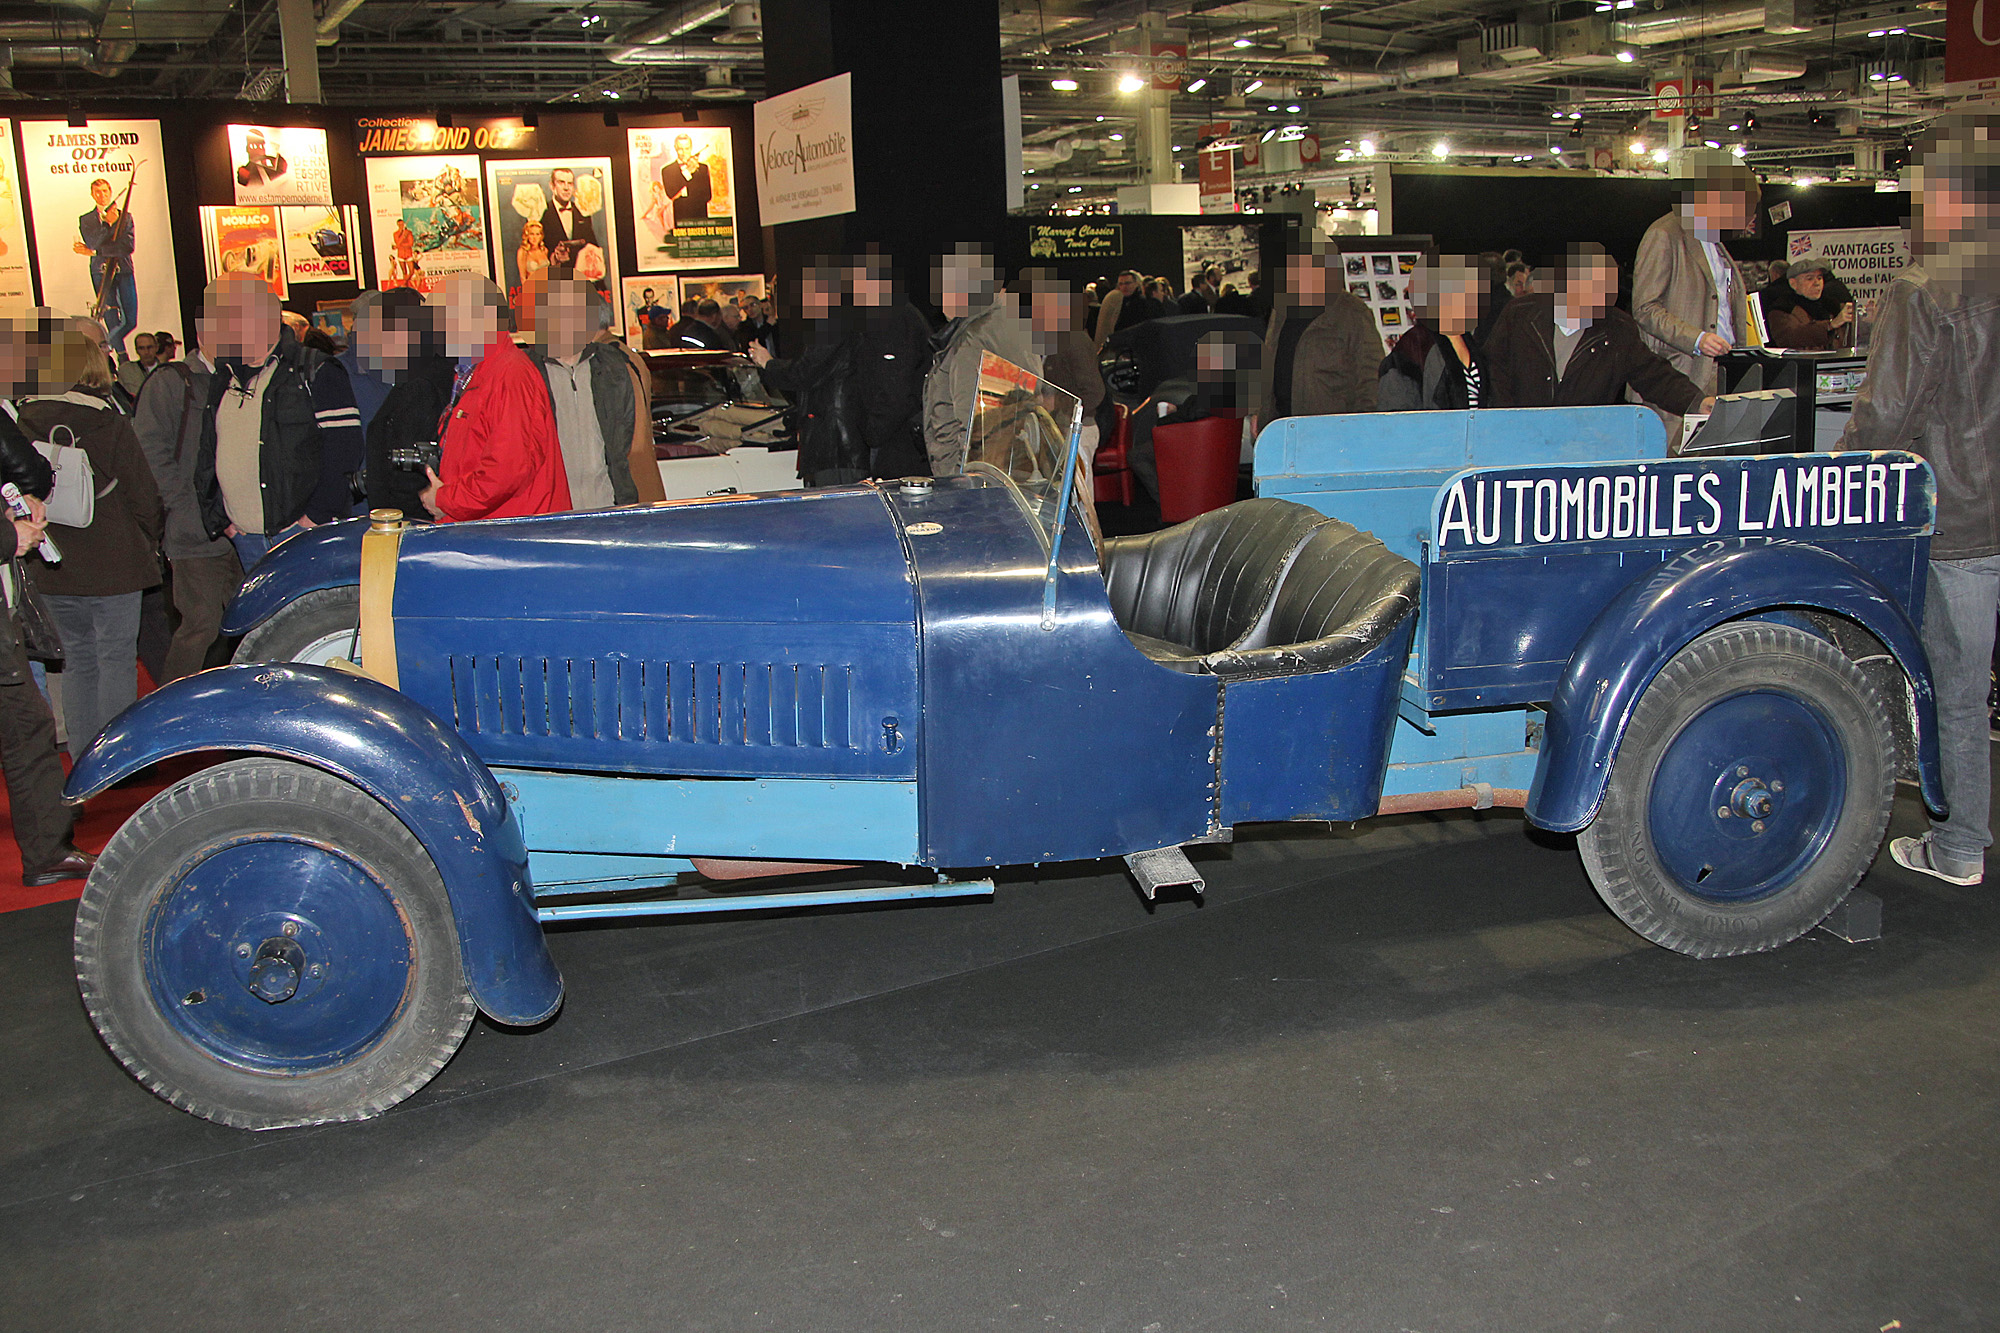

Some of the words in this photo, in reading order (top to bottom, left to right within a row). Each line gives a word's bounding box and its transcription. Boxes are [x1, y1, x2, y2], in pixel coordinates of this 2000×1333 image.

[358, 117, 420, 127] Collection
[48, 135, 97, 147] JAMES
[100, 133, 139, 145] BOND
[359, 129, 415, 151] JAMES
[72, 147, 109, 160] 007
[760, 130, 794, 186] Veloce
[794, 132, 846, 174] Automobile
[50, 163, 70, 174] est
[72, 161, 88, 173] de
[91, 161, 132, 173] retour
[296, 181, 329, 193] RTIVE
[237, 193, 331, 204] www.estampemoderne.fr
[221, 214, 270, 226] MONACO
[1078, 224, 1115, 237] Classics
[1064, 238, 1087, 248] Twin
[1089, 237, 1112, 249] Cam
[1822, 242, 1895, 256] AVANTAGES
[293, 260, 349, 274] MONACO
[1828, 256, 1904, 270] TOMOBILES
[1858, 273, 1872, 284] de
[1848, 288, 1877, 299] AINT
[1438, 464, 1722, 547] AUTOMOBILES
[1738, 462, 1917, 531] LAMBERT
